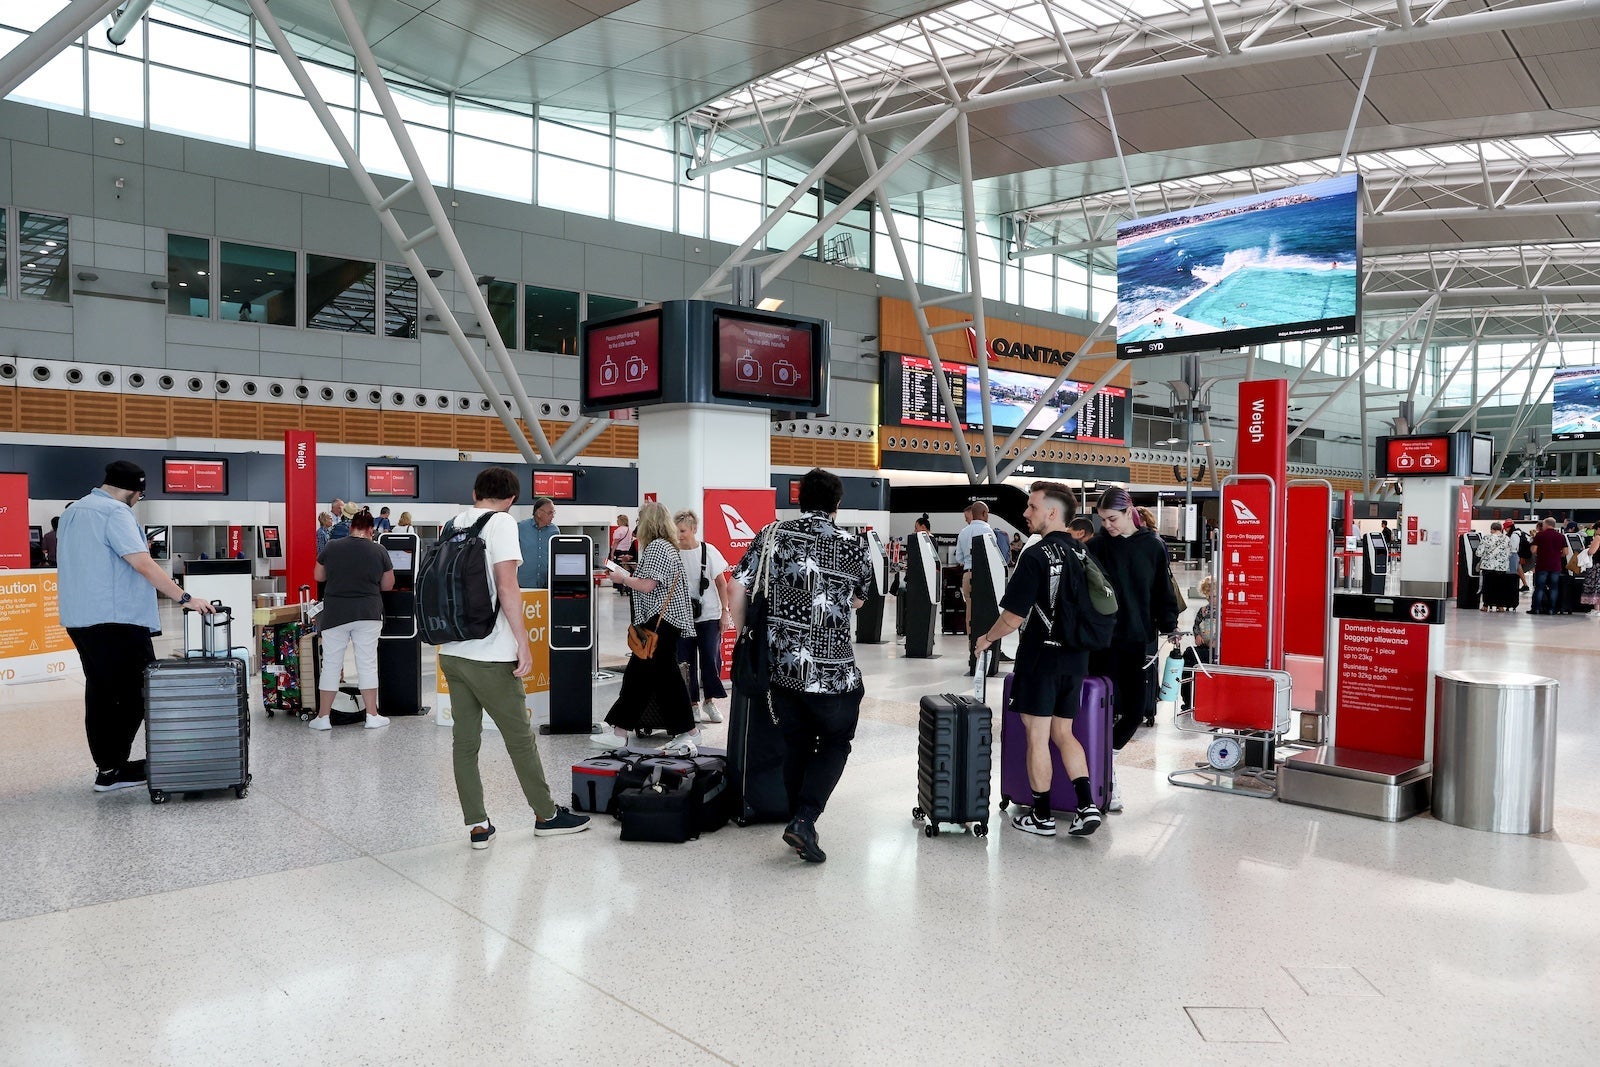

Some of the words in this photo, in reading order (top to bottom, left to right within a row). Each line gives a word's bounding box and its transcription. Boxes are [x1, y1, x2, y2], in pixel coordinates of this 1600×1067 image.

[992, 338, 1075, 366] QANTAS
[1148, 343, 1164, 351] SYD
[1249, 399, 1264, 442] Weigh
[296, 442, 306, 469] Weigh
[0, 581, 37, 594] aution
[1344, 624, 1375, 632] Domestic
[1377, 626, 1406, 634] checked
[1344, 634, 1373, 643] baggage
[1374, 636, 1408, 645] allowance
[1358, 654, 1373, 662] 23kg
[47, 661, 66, 674] SYD
